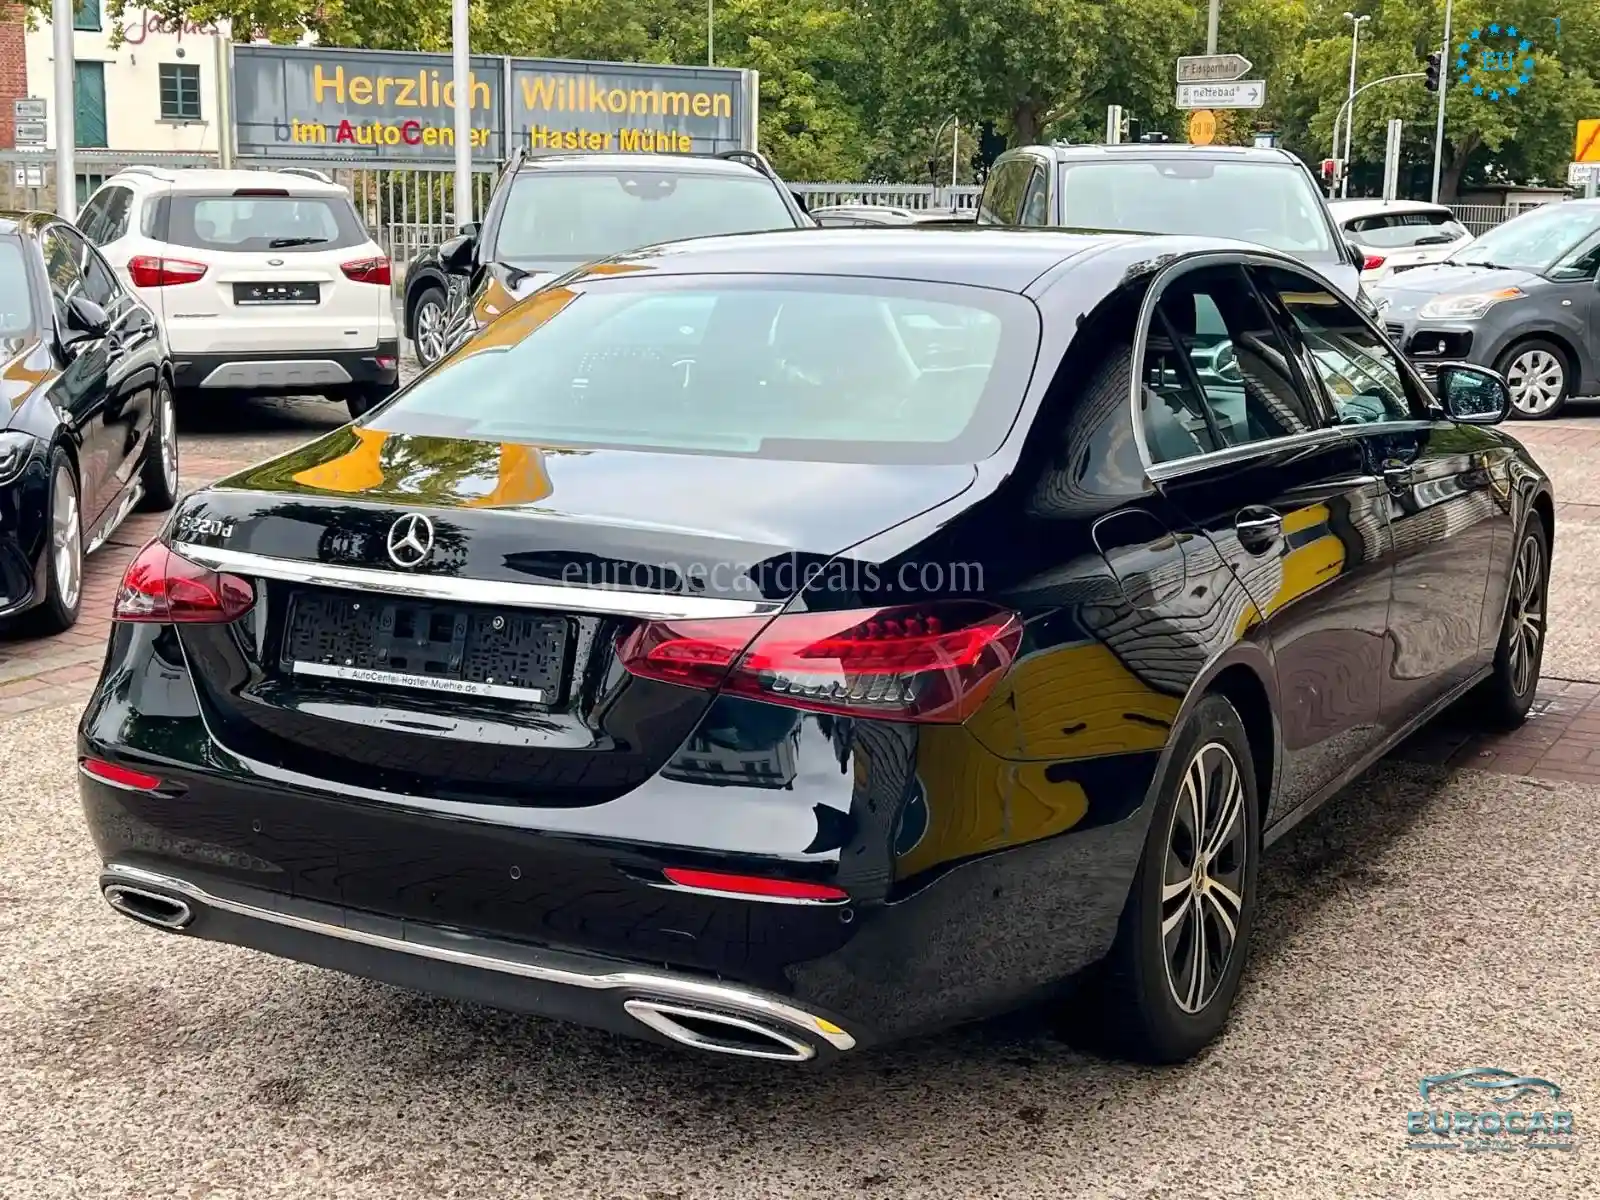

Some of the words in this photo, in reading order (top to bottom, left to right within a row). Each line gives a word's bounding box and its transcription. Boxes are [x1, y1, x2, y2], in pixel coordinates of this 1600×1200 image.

[313, 65, 491, 109] Herzlich
[521, 77, 732, 118] Willkommen
[292, 118, 326, 144] im
[336, 120, 491, 147] AutoCener
[531, 124, 613, 149] Haster
[618, 127, 692, 153] Mühle
